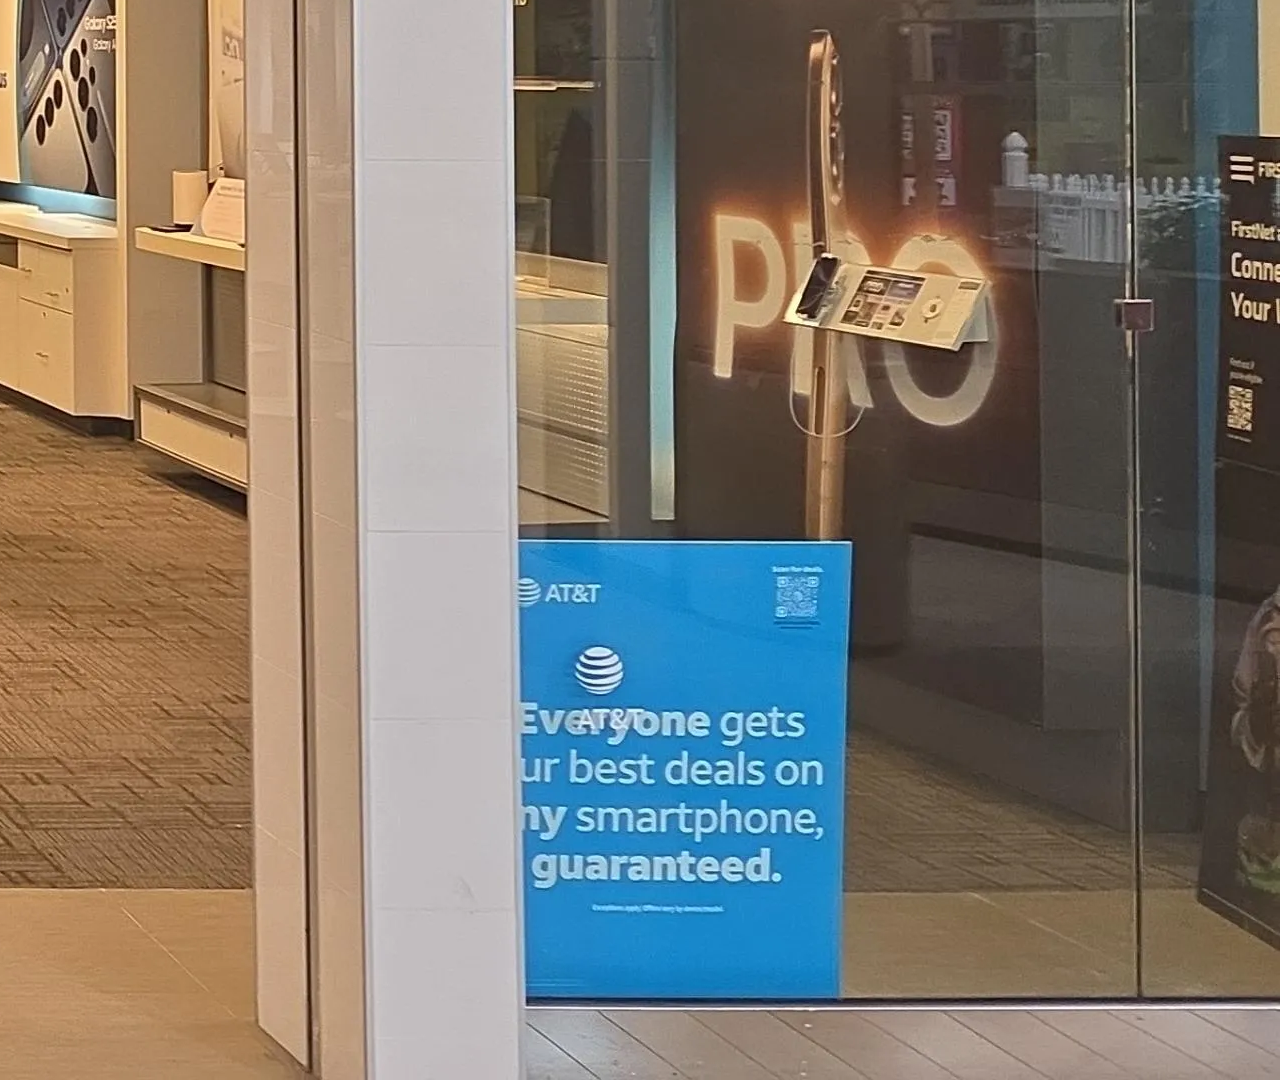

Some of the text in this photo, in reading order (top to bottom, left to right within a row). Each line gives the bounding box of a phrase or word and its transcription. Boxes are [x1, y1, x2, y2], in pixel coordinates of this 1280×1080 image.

[1231, 252, 1280, 284] Conne
[713, 214, 998, 426] PRO
[1230, 291, 1272, 322] Your
[545, 583, 602, 604] AT&T
[519, 701, 806, 747] Everyone gets
[578, 707, 645, 730] AT&T
[521, 749, 824, 786] ur best deals on
[575, 799, 824, 843] smartphone,
[531, 847, 783, 889] guaranteed.
